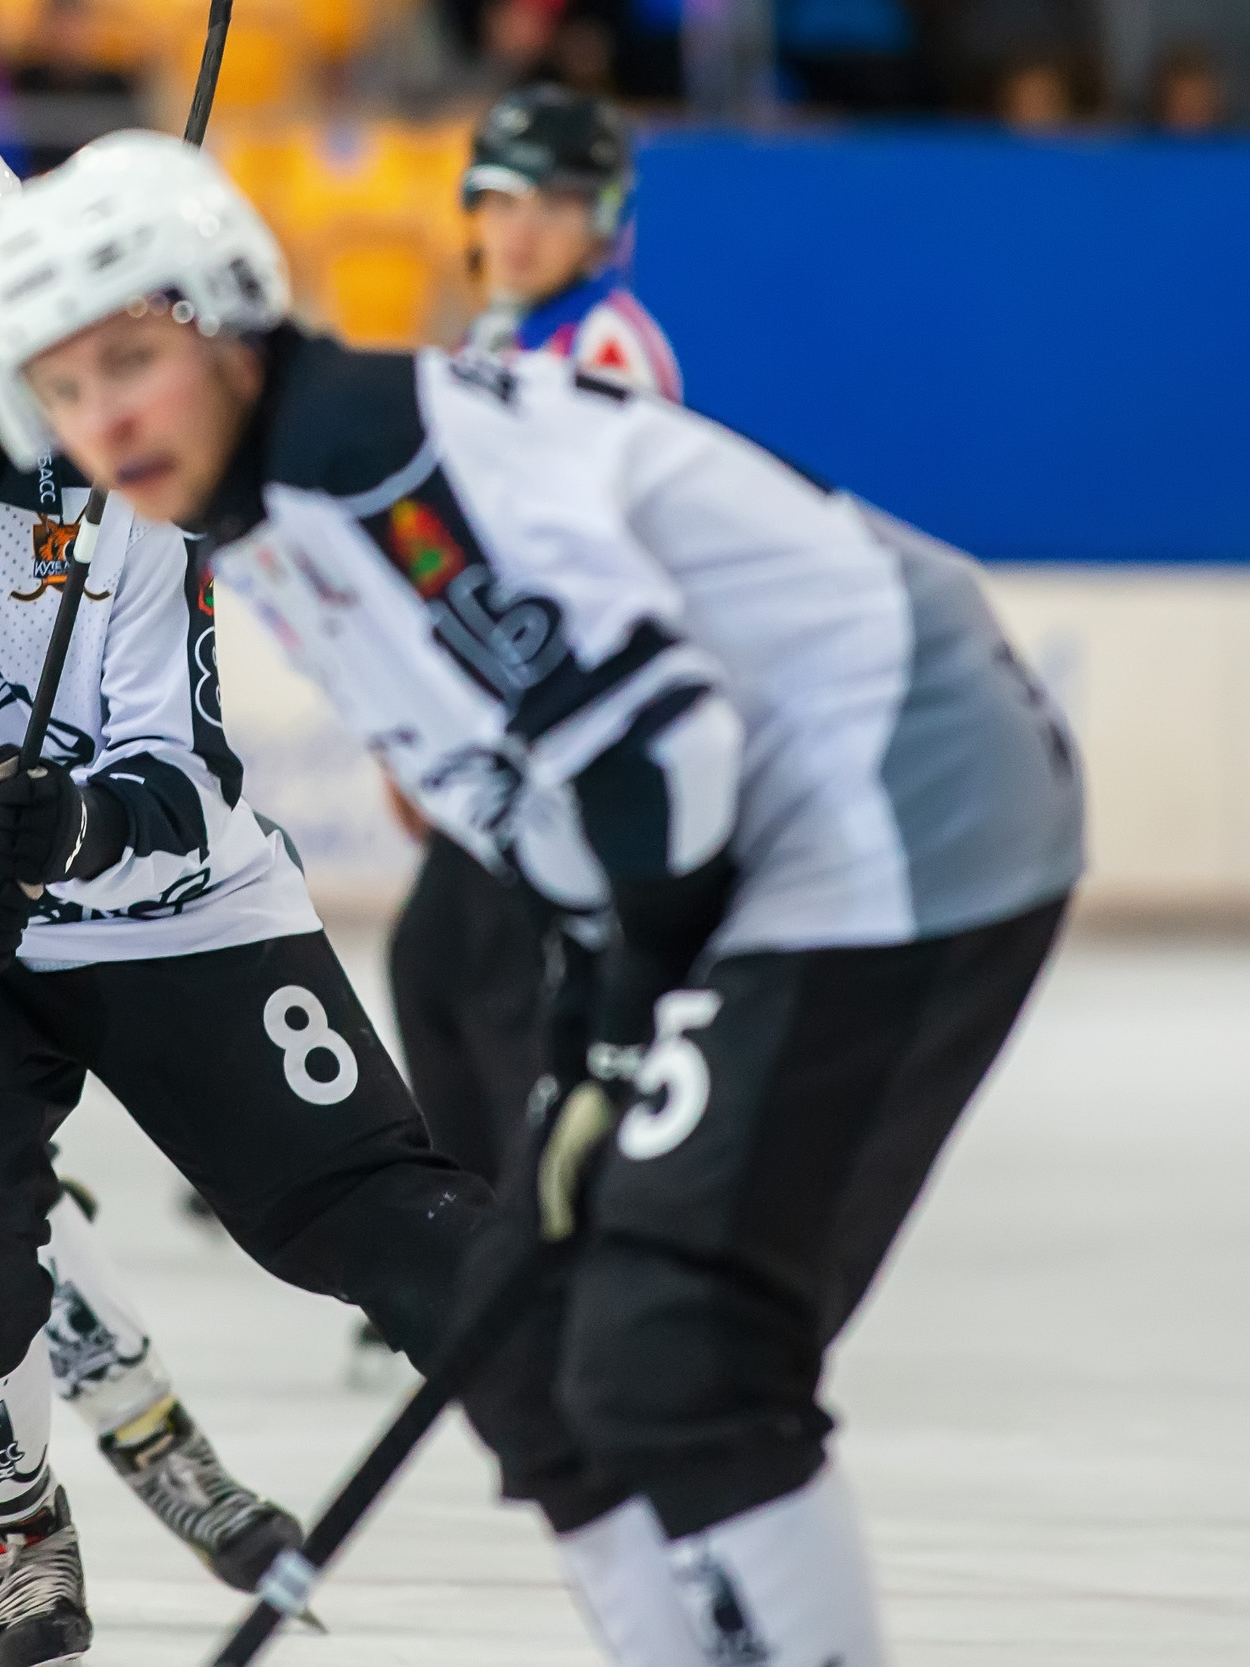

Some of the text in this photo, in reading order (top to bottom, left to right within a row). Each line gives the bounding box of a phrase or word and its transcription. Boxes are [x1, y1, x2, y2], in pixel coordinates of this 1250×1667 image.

[37, 445, 56, 504] БАСС
[264, 985, 358, 1105] 8
[617, 989, 723, 1160] 5
